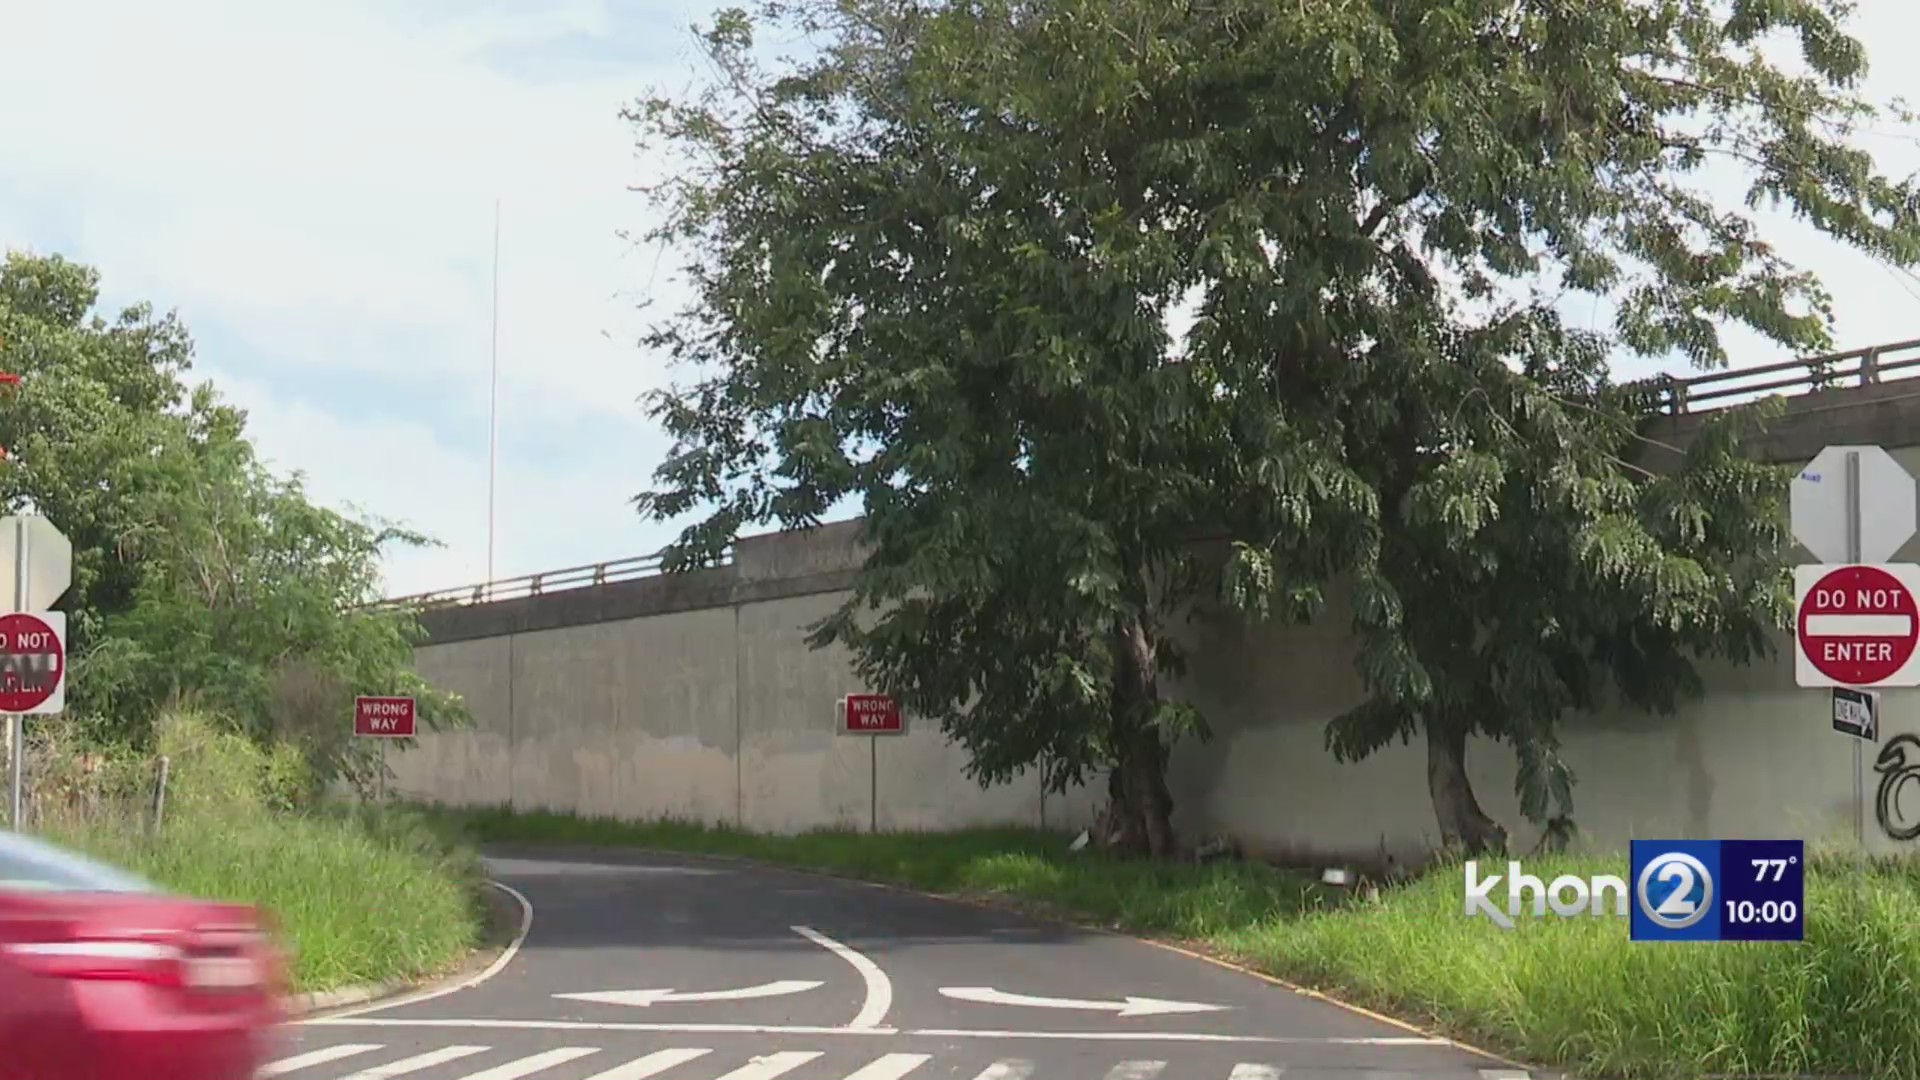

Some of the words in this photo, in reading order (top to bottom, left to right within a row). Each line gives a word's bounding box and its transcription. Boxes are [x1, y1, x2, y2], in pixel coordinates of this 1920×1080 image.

[1816, 589, 1846, 609] DO
[1857, 589, 1902, 609] NOT
[17, 632, 50, 649] NOT
[1823, 643, 1893, 662] ENTER
[362, 703, 409, 716] WRONG
[370, 717, 399, 731] WAY
[861, 713, 886, 726] WAY
